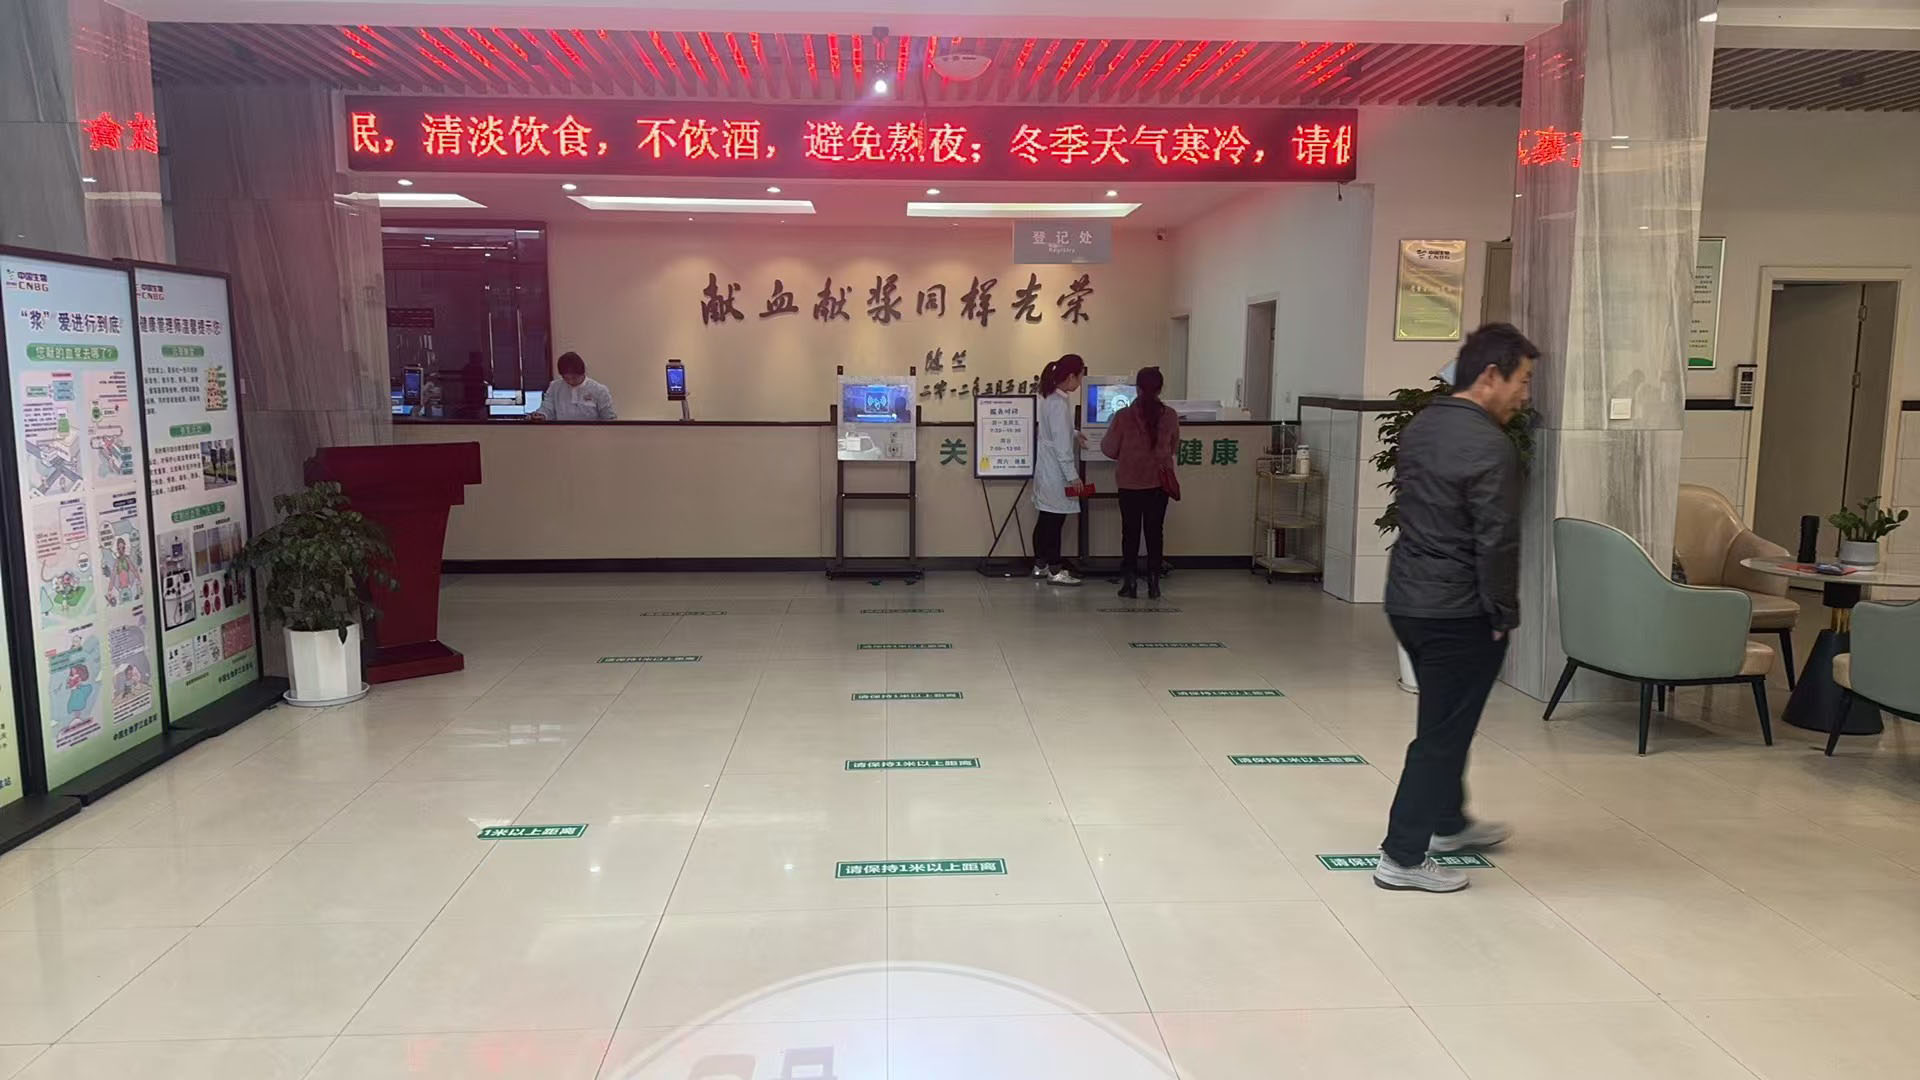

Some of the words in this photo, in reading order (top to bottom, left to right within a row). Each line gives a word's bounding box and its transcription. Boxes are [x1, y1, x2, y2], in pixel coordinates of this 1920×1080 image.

[1032, 230, 1093, 245] 登记处
[18, 281, 49, 292] CNBG
[701, 272, 1094, 326] 献血献浆同样光荣
[940, 438, 967, 465] 关
[1176, 438, 1239, 466] 健康
[853, 759, 973, 768] 请保持1米以上距离
[845, 861, 998, 875] 请保持1米以上距离
